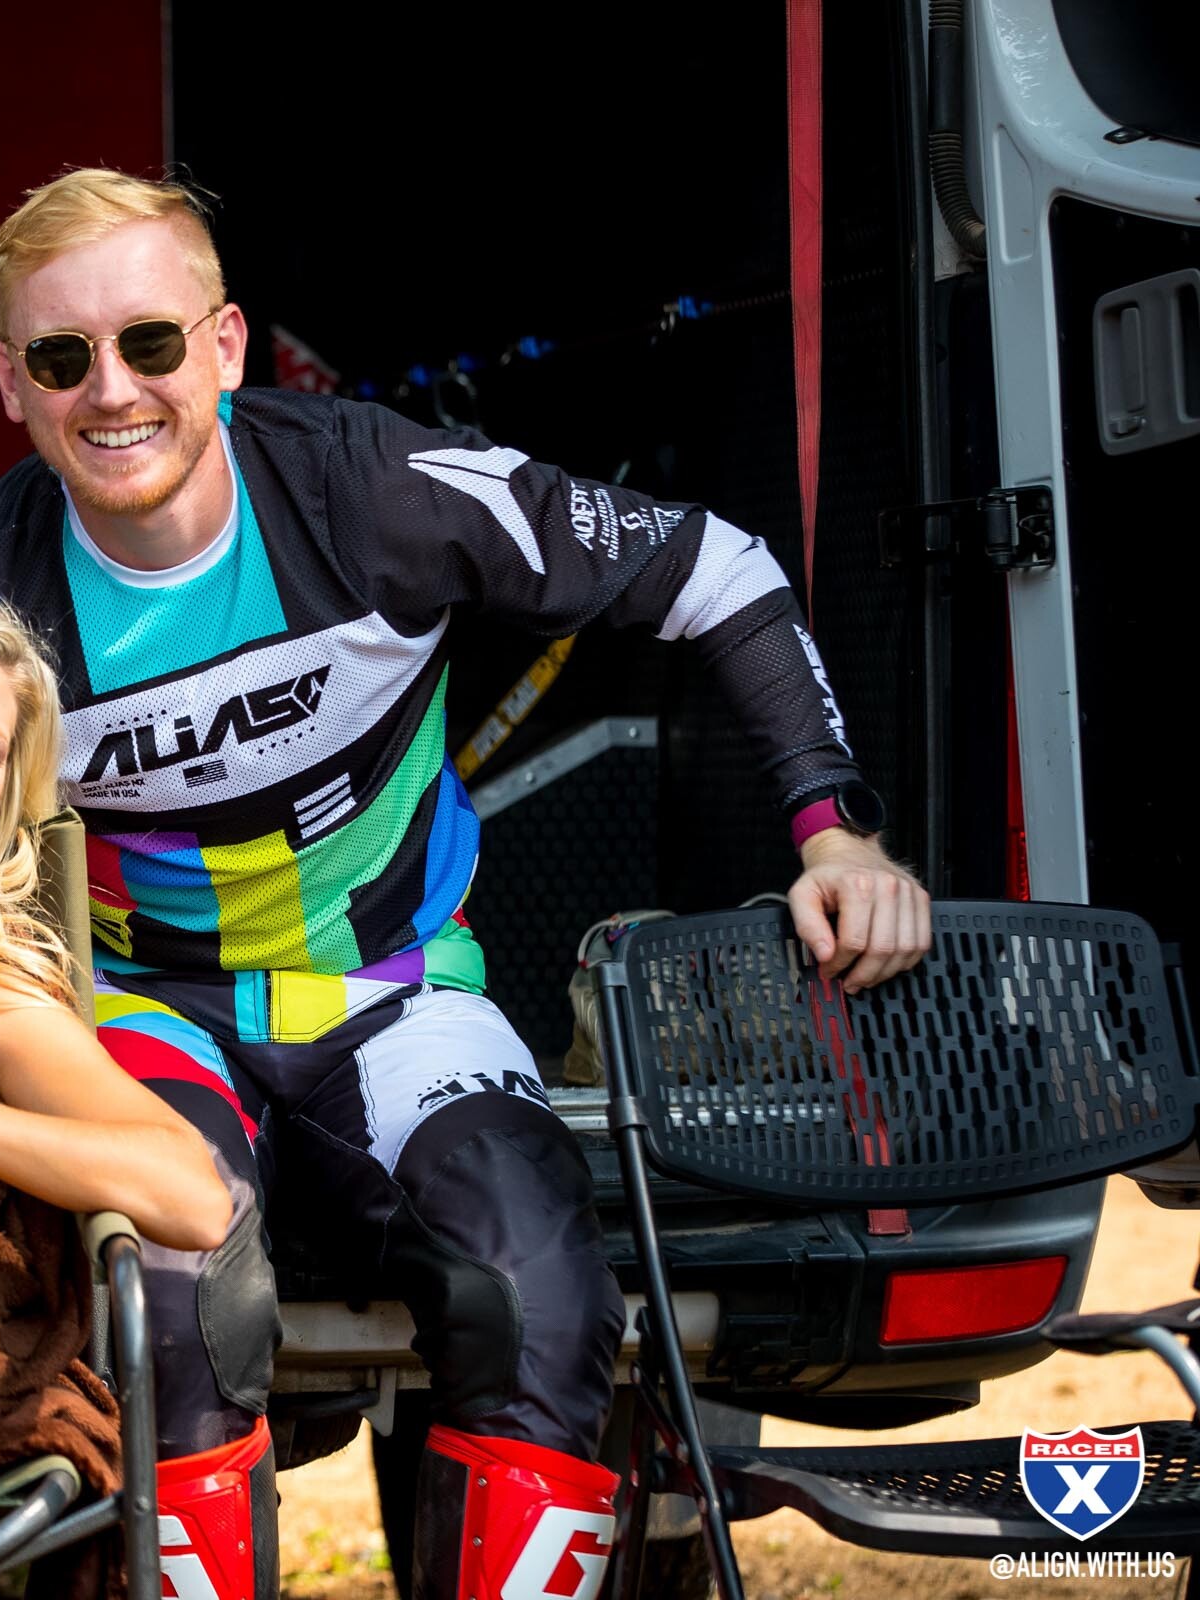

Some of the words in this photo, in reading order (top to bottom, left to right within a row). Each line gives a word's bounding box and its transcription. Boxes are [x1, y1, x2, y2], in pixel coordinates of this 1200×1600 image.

[79, 664, 331, 784] ALIAS
[104, 780, 131, 790] ALIAS
[131, 777, 146, 787] MX
[84, 789, 110, 798] MADE
[111, 788, 121, 798] IN
[121, 788, 141, 798] USA
